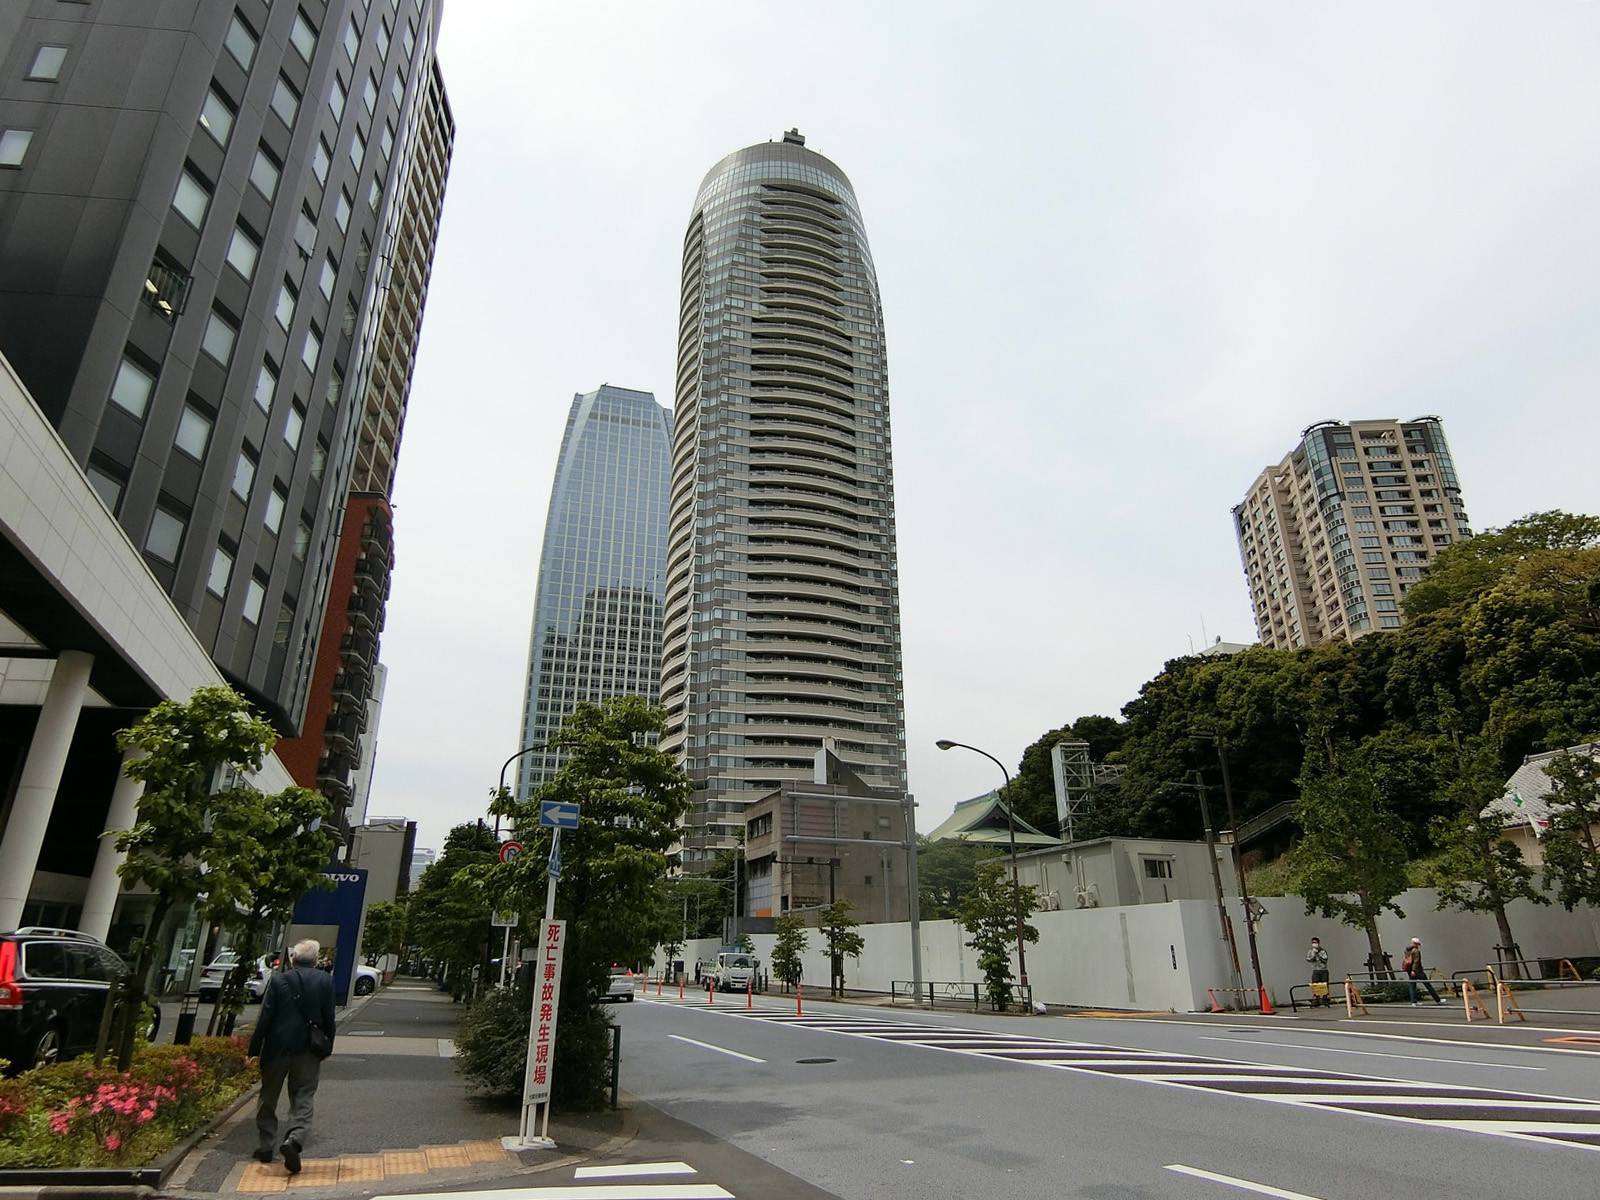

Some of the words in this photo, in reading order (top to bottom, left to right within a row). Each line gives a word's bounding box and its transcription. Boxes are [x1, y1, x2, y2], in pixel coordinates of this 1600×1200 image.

[315, 872, 360, 882] OLVO
[534, 924, 561, 1085] 死亡事故発生現場
